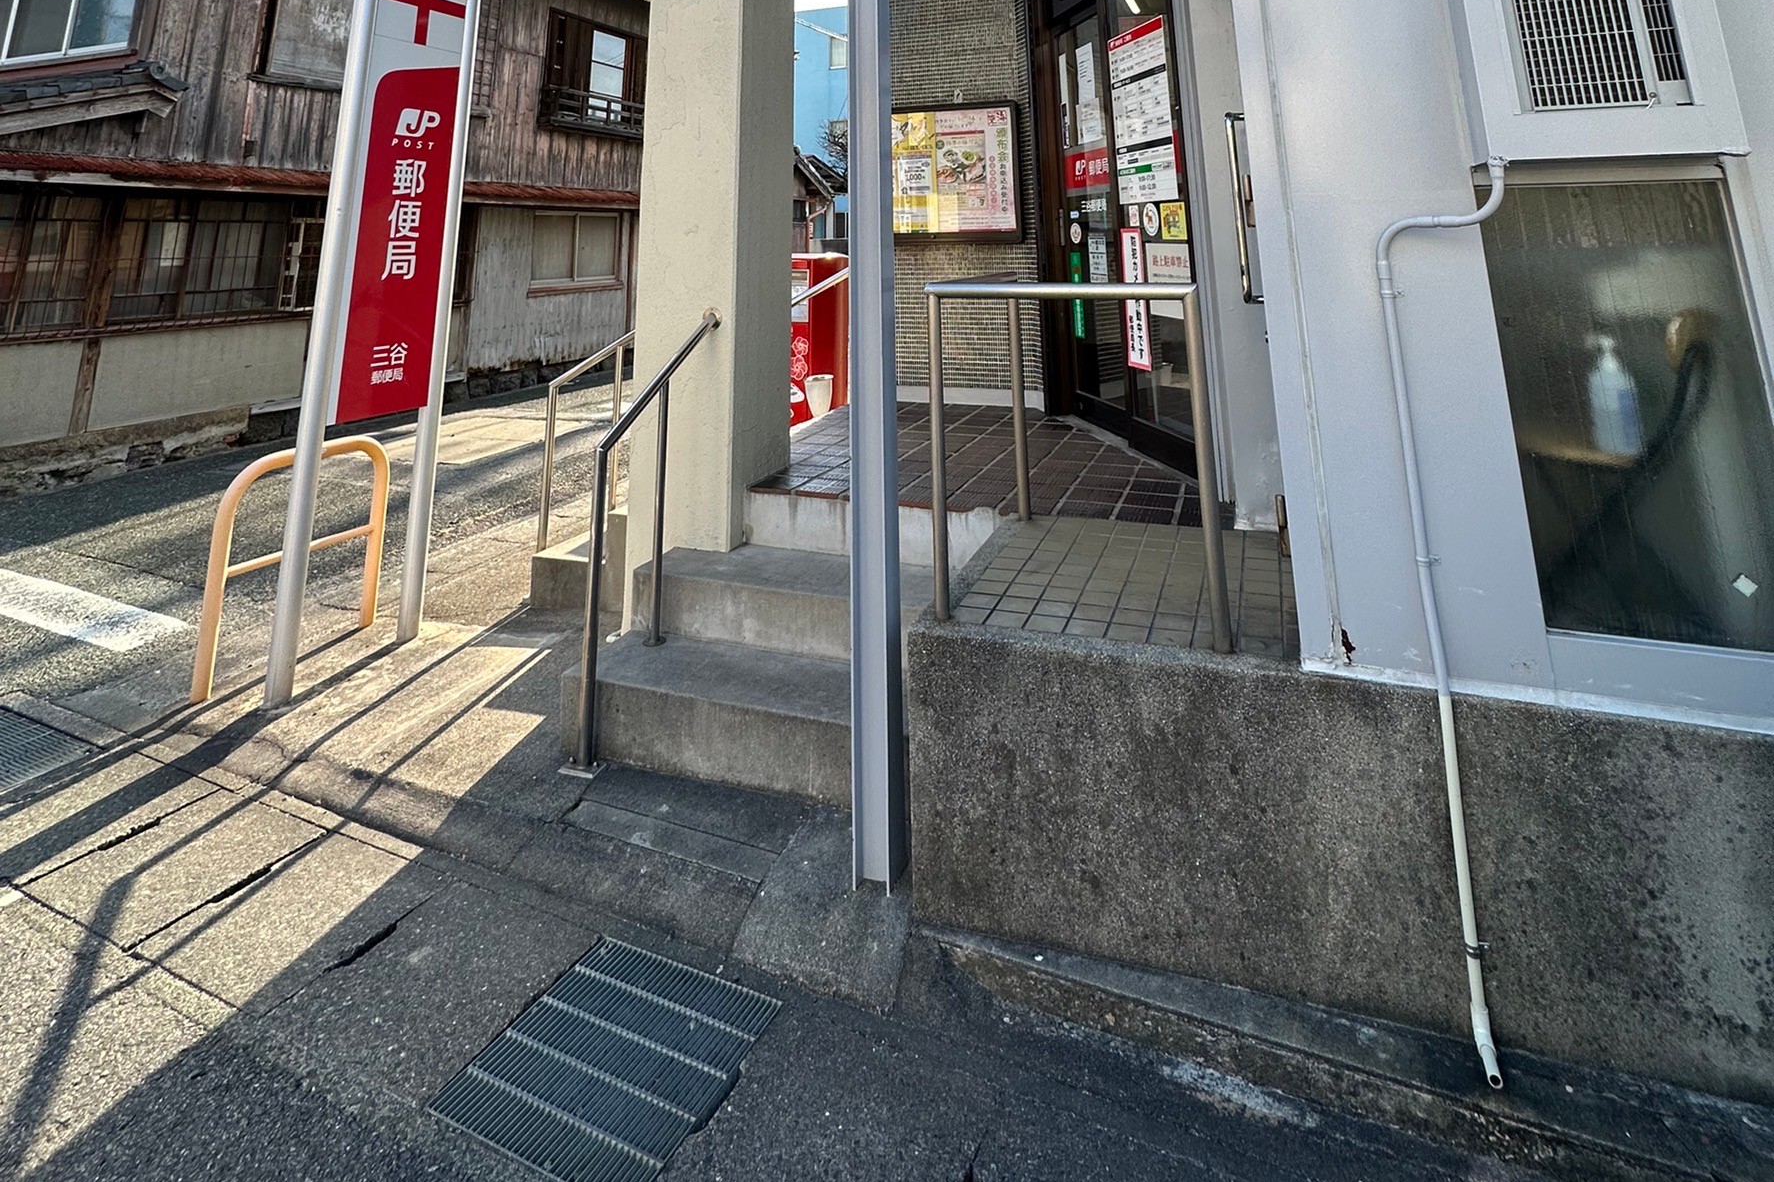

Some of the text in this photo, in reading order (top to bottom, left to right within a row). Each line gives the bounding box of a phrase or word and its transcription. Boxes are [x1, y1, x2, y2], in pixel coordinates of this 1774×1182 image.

[395, 108, 441, 137] JP
[391, 138, 435, 150] POST
[1088, 158, 1109, 175] 郵便局
[381, 158, 427, 281] 郵便局
[370, 342, 408, 367] 三谷
[370, 367, 404, 385] 郵便局
